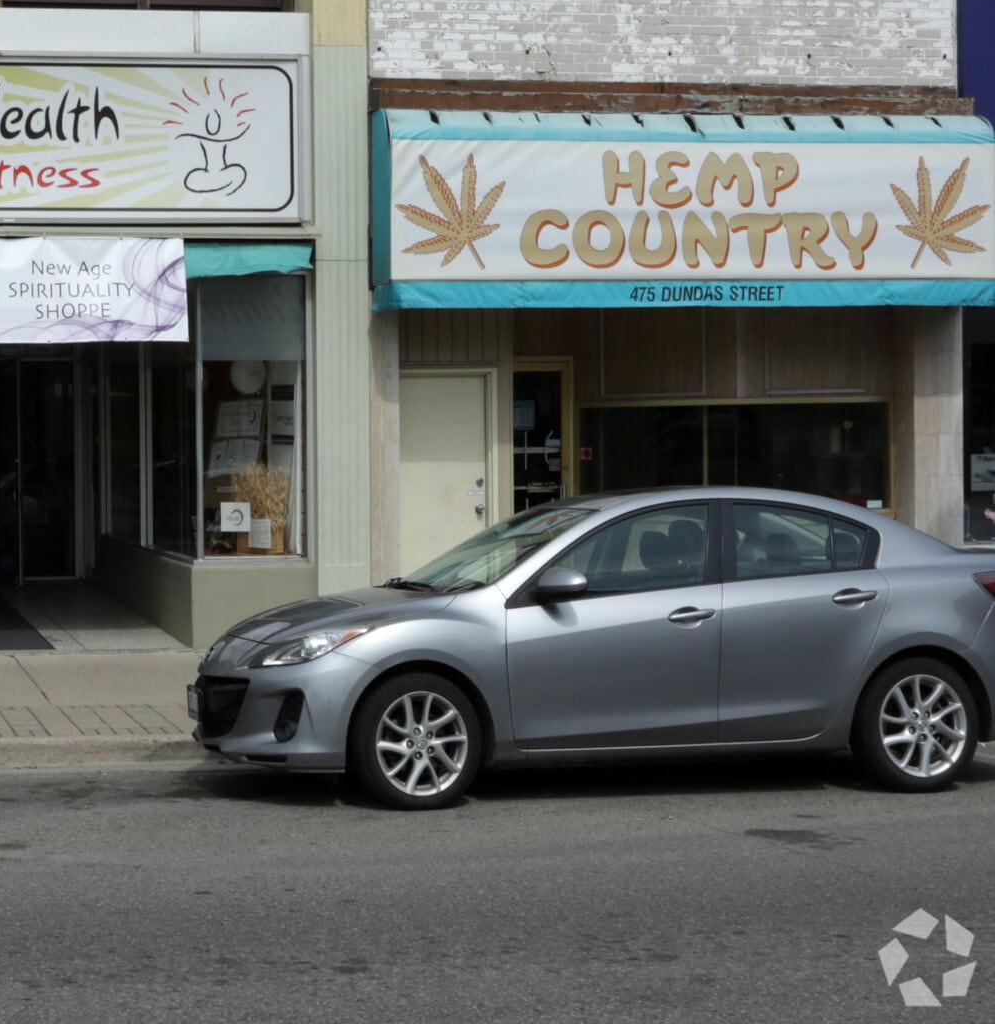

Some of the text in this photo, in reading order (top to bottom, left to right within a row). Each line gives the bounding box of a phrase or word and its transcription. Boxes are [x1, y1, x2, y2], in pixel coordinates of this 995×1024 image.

[602, 149, 800, 209] HEMP
[520, 208, 878, 271] COUNTRY
[31, 260, 111, 280] New Age
[8, 282, 136, 299] SPIRITUALITY
[630, 285, 785, 302] 475 DUNDAS STREET
[35, 302, 111, 320] SHOPPE
